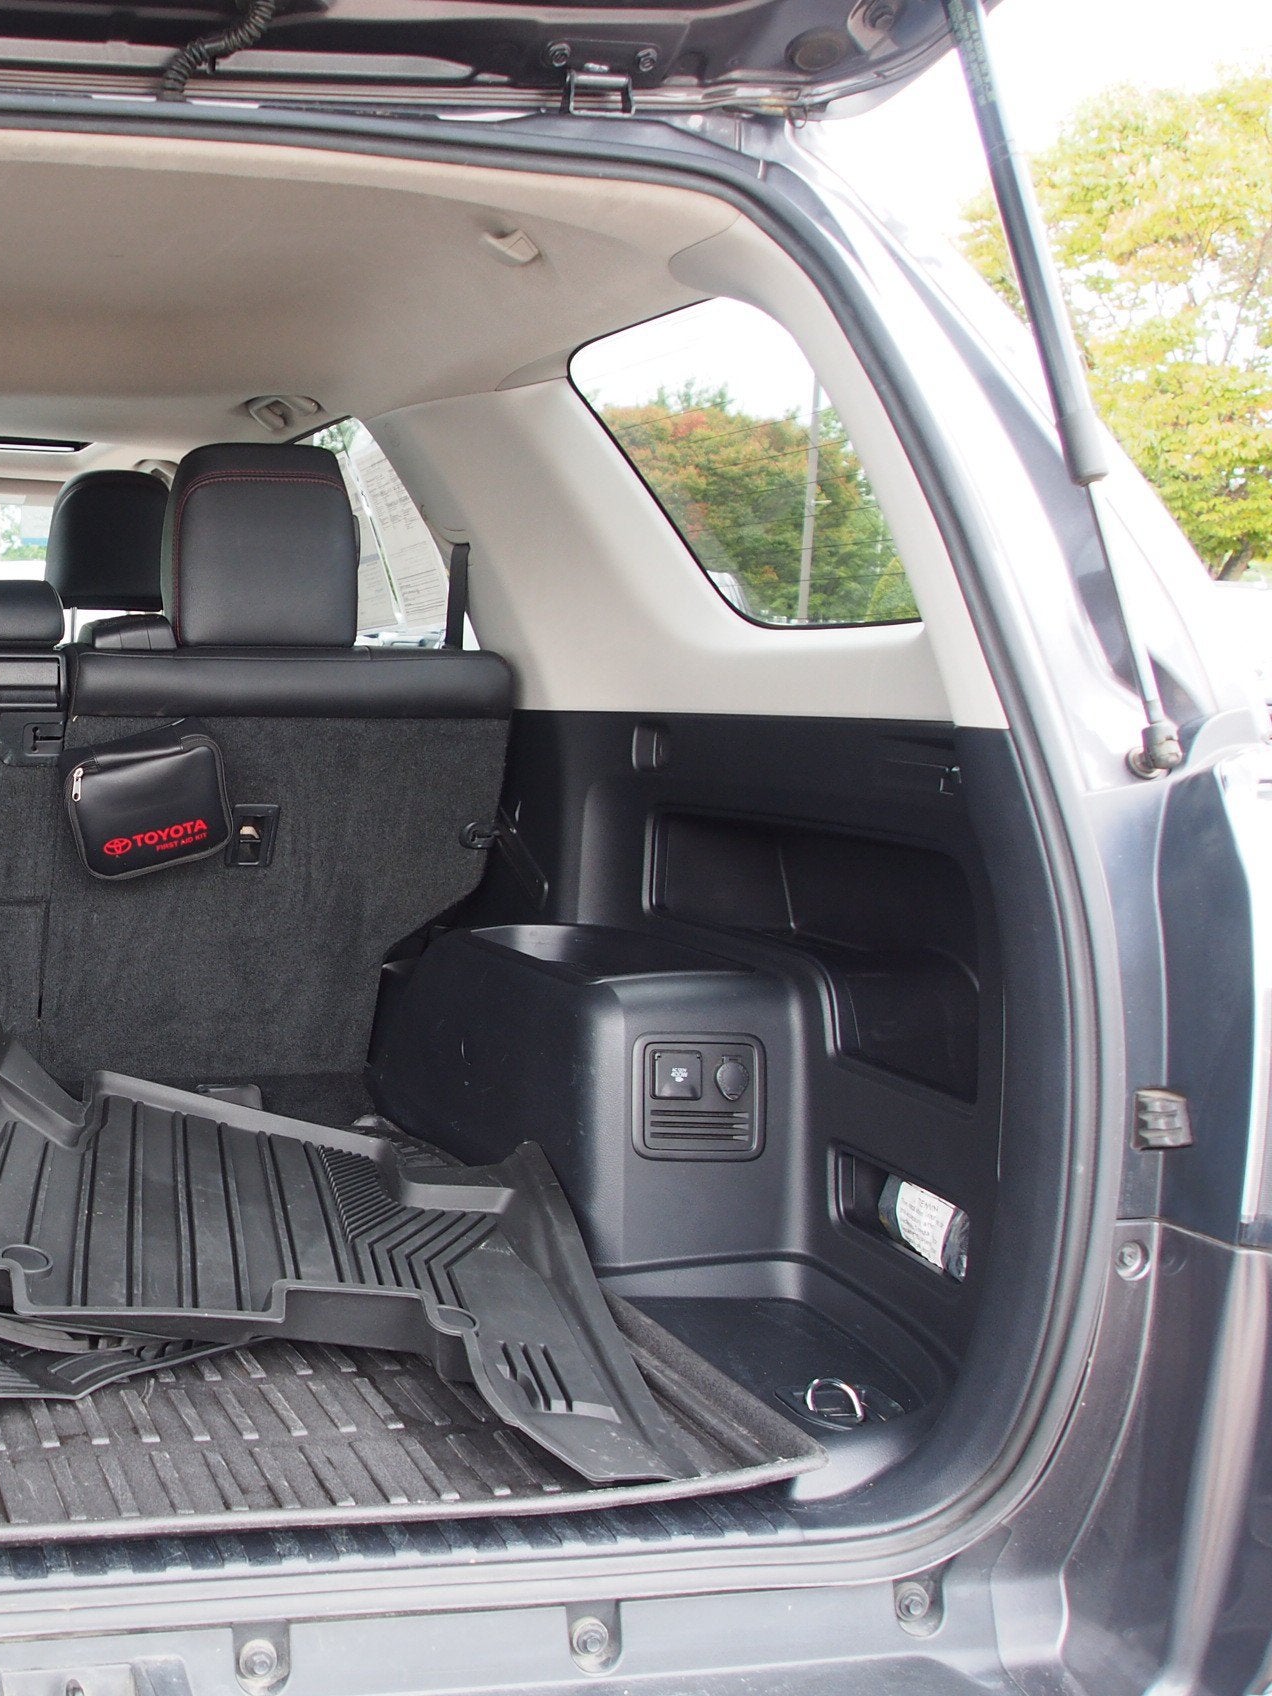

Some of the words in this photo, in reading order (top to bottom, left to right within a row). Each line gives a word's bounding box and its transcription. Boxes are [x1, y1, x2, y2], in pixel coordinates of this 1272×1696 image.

[132, 819, 208, 847] TOYOTA
[156, 841, 179, 852] FIRST
[180, 836, 194, 846] AID
[195, 832, 208, 841] KIT
